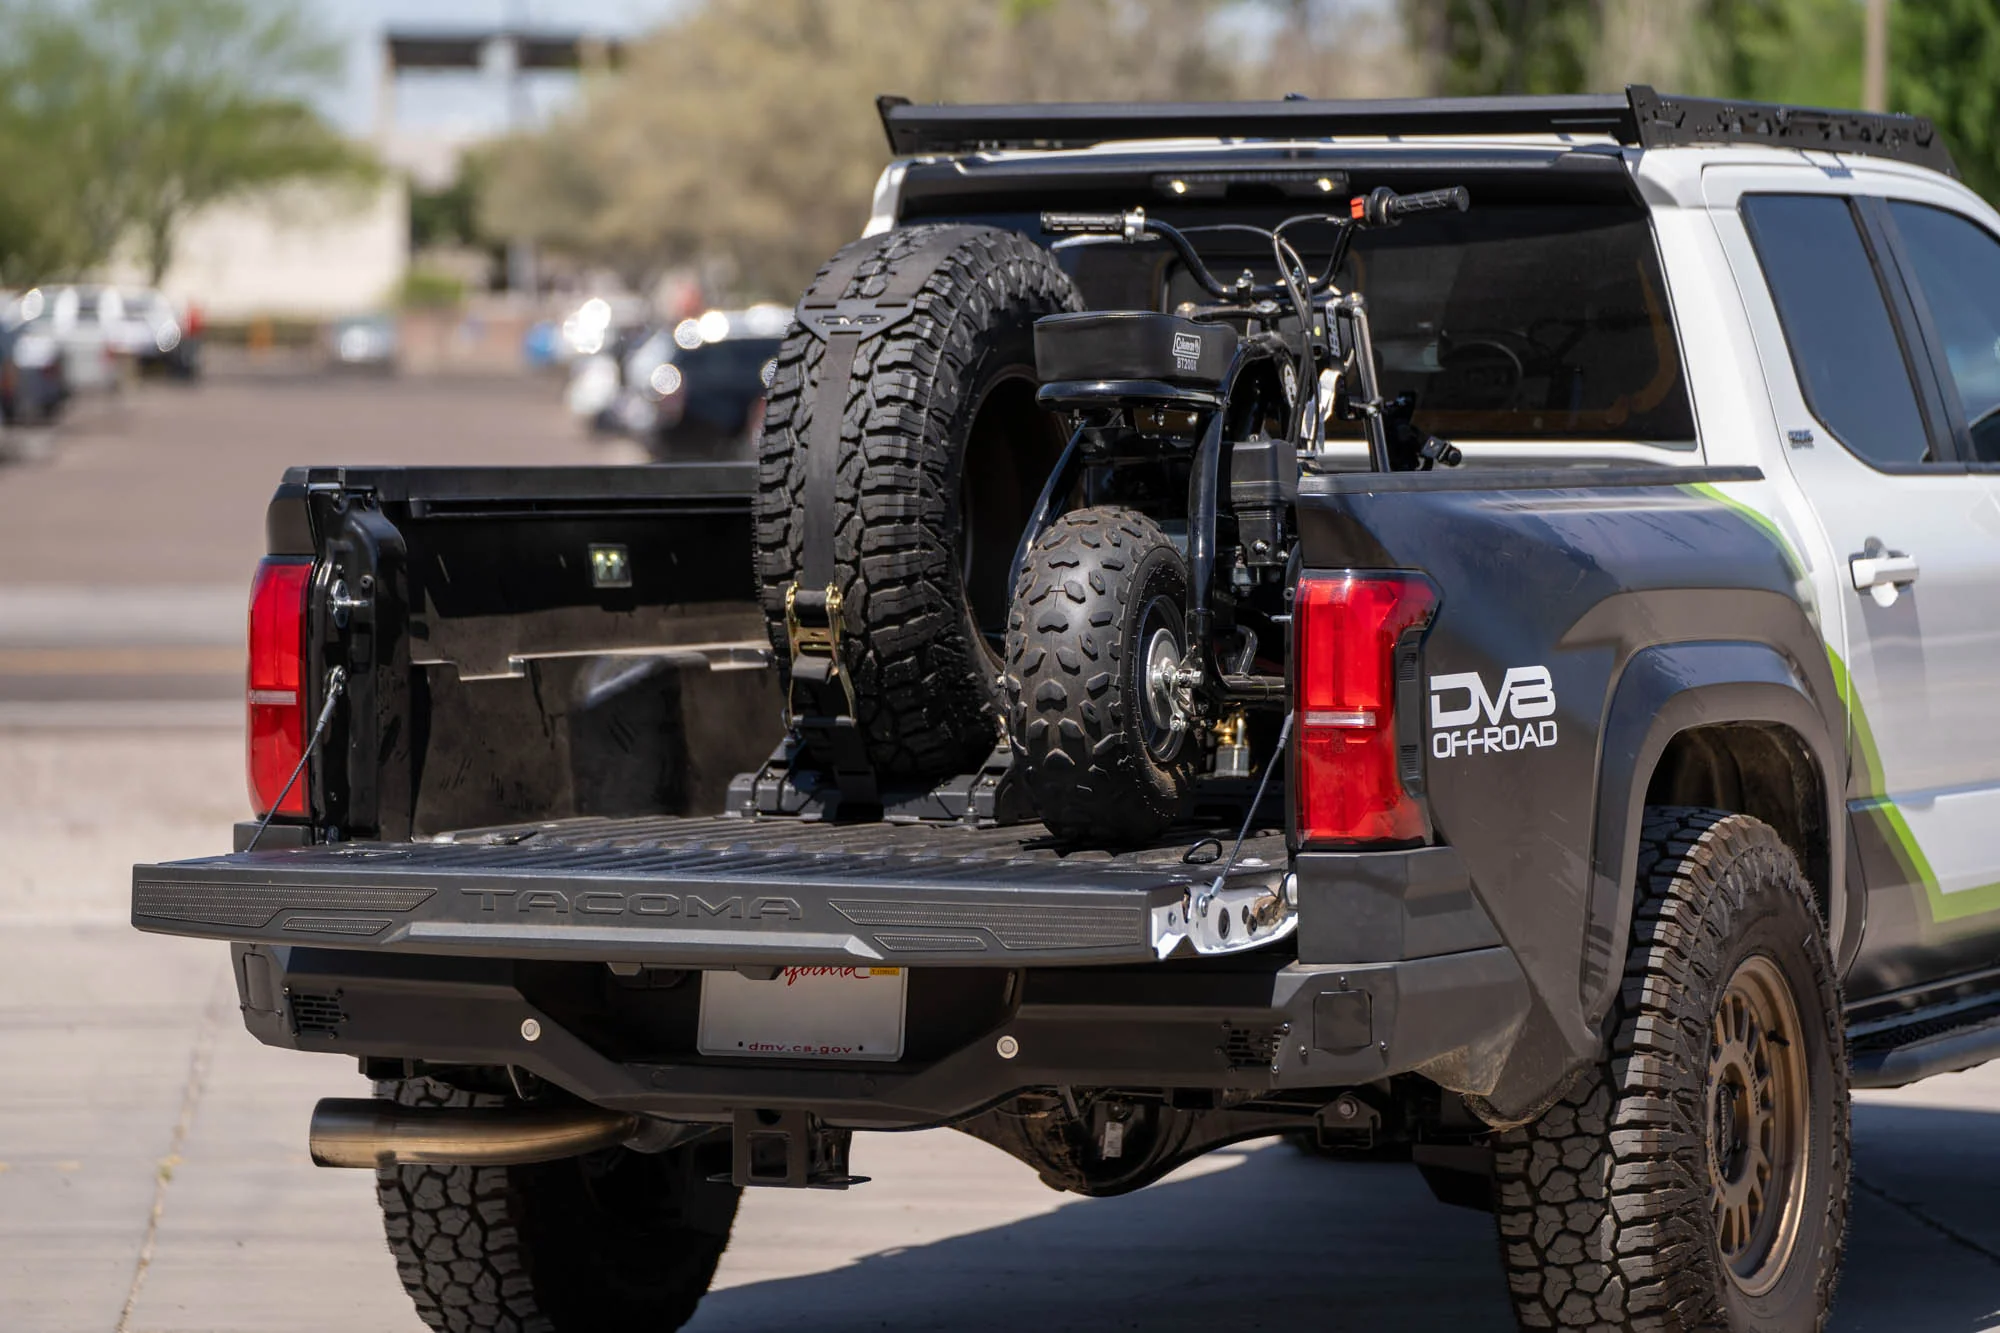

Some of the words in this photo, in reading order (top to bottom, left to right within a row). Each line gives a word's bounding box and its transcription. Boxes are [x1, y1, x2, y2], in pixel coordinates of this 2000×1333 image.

[1430, 665, 1556, 728] DV8
[460, 887, 803, 921] TACOMA
[748, 1041, 853, 1055] dmv.ca.gov
